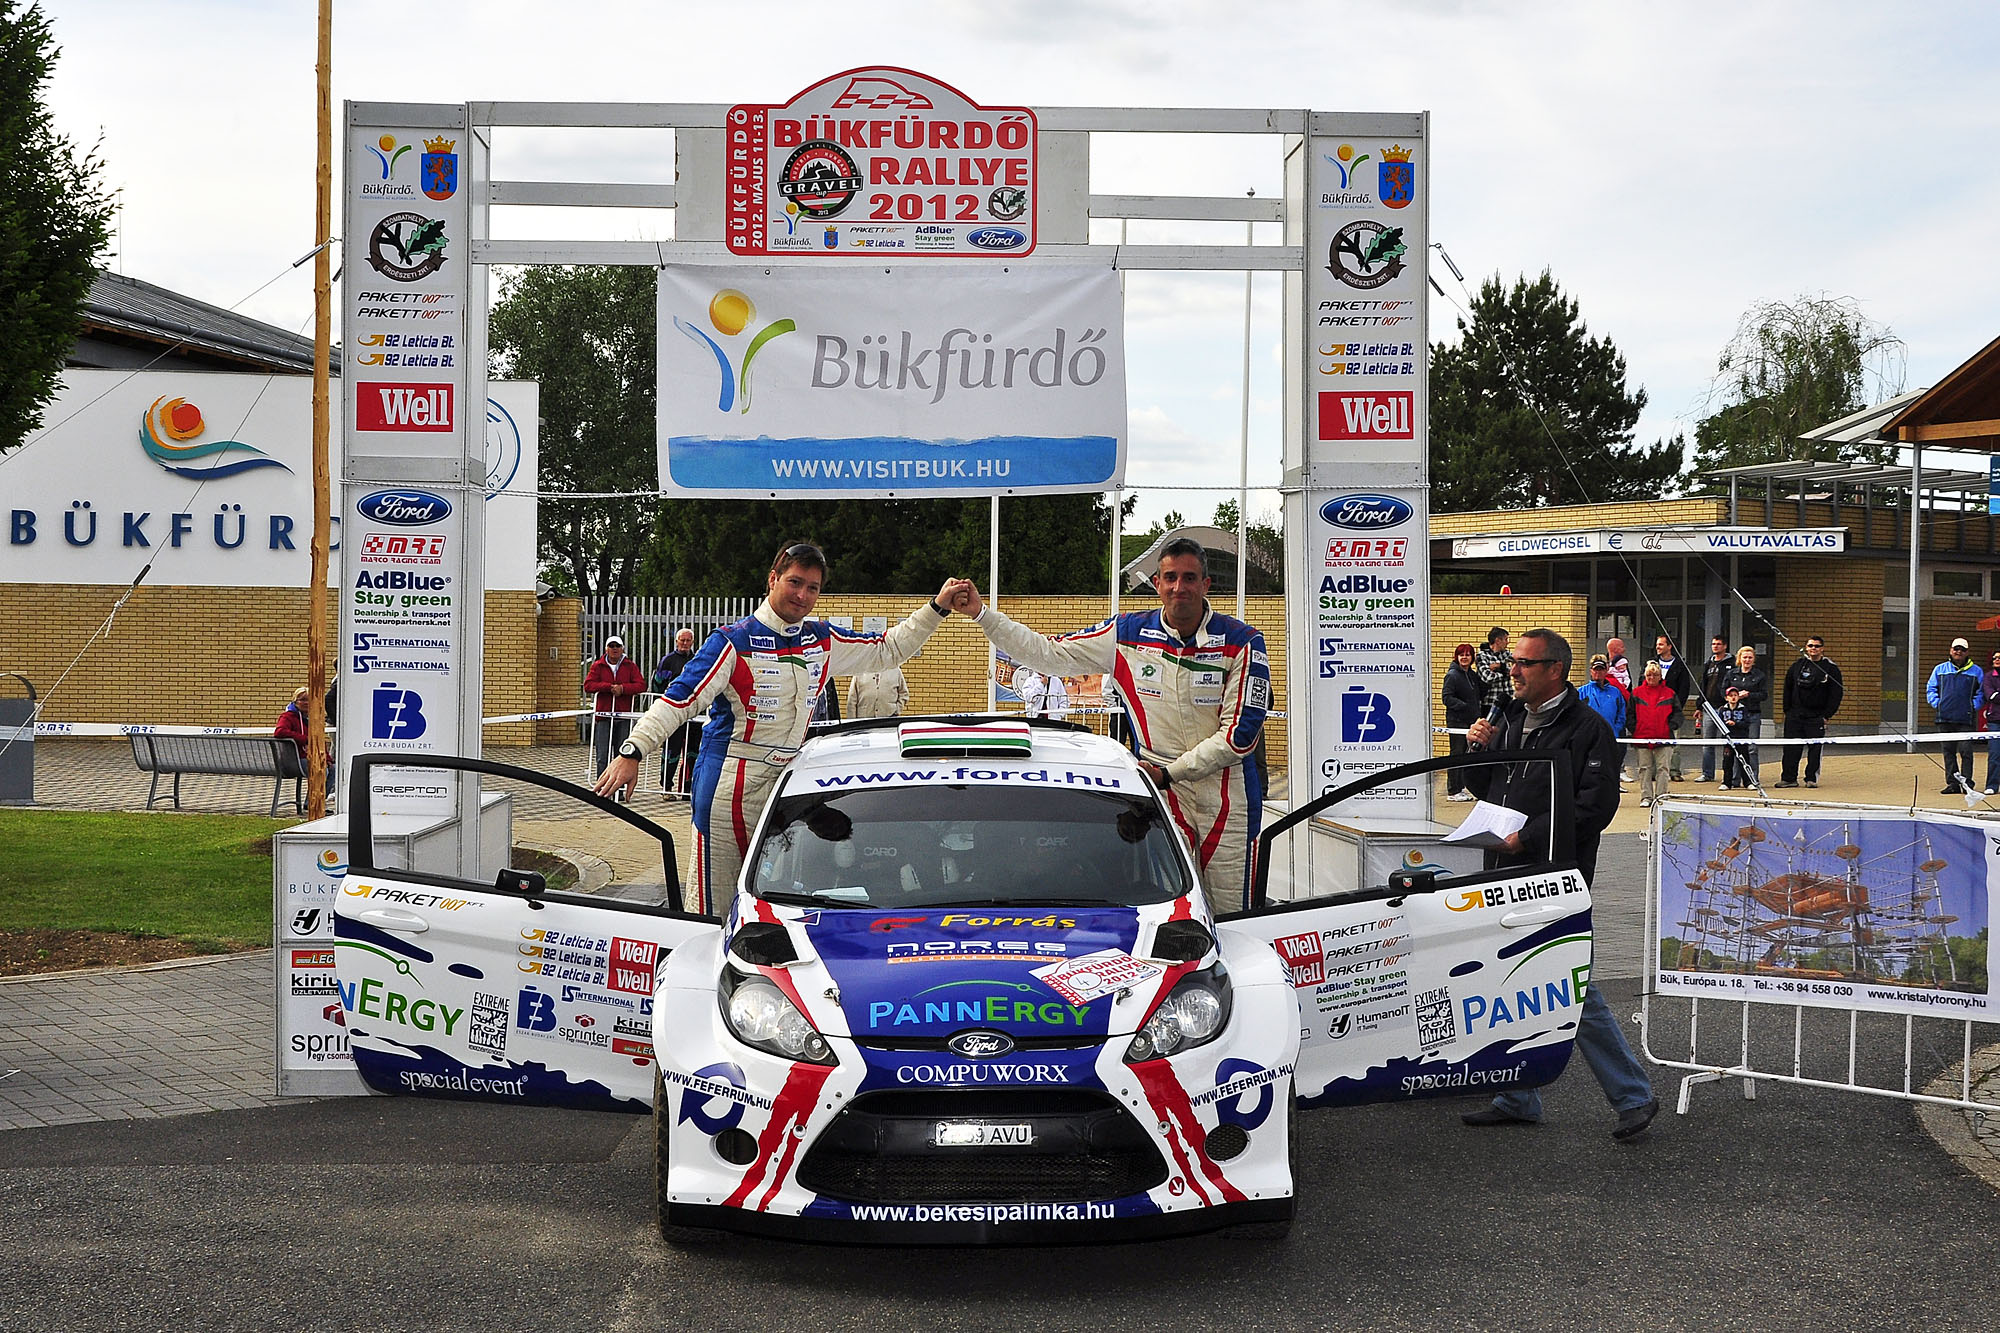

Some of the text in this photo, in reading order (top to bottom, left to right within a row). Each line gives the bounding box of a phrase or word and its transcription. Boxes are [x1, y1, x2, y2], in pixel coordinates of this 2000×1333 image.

[774, 115, 1028, 149] BÜKFÜRDŐ
[730, 110, 747, 247] BÜKFÜRDŐ
[750, 110, 764, 248] 2012. MÁJUS 11-13.
[870, 157, 1028, 186] RALLYE
[783, 180, 859, 193] GRAVEL
[870, 194, 979, 220] 2012
[382, 214, 424, 227] SZOMBATHELYI
[976, 231, 1015, 246] Ford
[382, 264, 417, 279] ERDÉSZETI
[385, 335, 454, 348] 92 Leticia Bt.
[1346, 344, 1414, 355] 92 Leticia Bt.
[385, 354, 454, 367] 92 Leticia Bt.
[811, 328, 1108, 404] Bükfürdő
[1346, 363, 1414, 374] 92 Leticia Bt.
[379, 389, 449, 425] Well
[1341, 397, 1410, 433] Well
[772, 458, 1010, 479] WWW.VISITBUK.HU
[374, 494, 434, 520] Ford
[1337, 499, 1396, 523] Ford
[1498, 535, 1591, 553] GELDWECHSEL
[1707, 532, 1837, 548] VALUTAVÁLTÁS
[355, 591, 451, 608] Stay green
[1320, 596, 1414, 611] Stay green
[354, 609, 399, 617] Dealership
[412, 610, 451, 618] transport
[1320, 614, 1363, 622] Dealership
[1376, 613, 1414, 621] transport
[372, 639, 450, 647] INTERNATIONAL
[371, 661, 450, 670] INTERNATIONAL
[815, 767, 1121, 789] www.ford.hu
[1484, 875, 1583, 906] 92 Leticia Bt.
[940, 914, 1076, 929] Forrás
[544, 931, 607, 953] 92 Leticia Bt.
[1282, 934, 1320, 959] Well
[543, 948, 607, 969] 92 Leticia Bt.
[619, 940, 654, 965] Well
[541, 964, 605, 985] 92 Leticia Bt.
[1095, 961, 1143, 978] RALLYE
[1103, 971, 1137, 985] 2012
[1354, 970, 1406, 987] Stay green
[616, 968, 650, 992] Well
[474, 992, 510, 1011] EXTREME
[575, 992, 635, 1008] INTERNATIONAL
[1317, 990, 1359, 1004] Dealership
[1371, 980, 1407, 992] transport
[1319, 989, 1407, 1013] www.europartnersk.net
[1415, 986, 1450, 1007] EXTREME
[1682, 976, 1717, 990] Európa
[1730, 979, 1745, 989] 18.
[1753, 979, 1773, 991] Tel.:
[1776, 982, 1794, 993] +36
[1796, 983, 1809, 993] 94
[1811, 984, 1831, 995] 558
[1833, 985, 1853, 997] 030
[1867, 988, 1987, 1009] www.kristalytorony.hu
[559, 1027, 610, 1044] sprinter
[963, 1035, 999, 1051] Ford
[312, 1053, 325, 1061] egy
[896, 1064, 1069, 1084] COMPUWORX
[663, 1069, 771, 1110] WWW.FEFERRUM.HU
[1191, 1063, 1294, 1107] WWW.FEFERRUM.HU
[990, 1128, 1028, 1143] AVU
[851, 1202, 1115, 1224] www.bekesipalinka.hu
